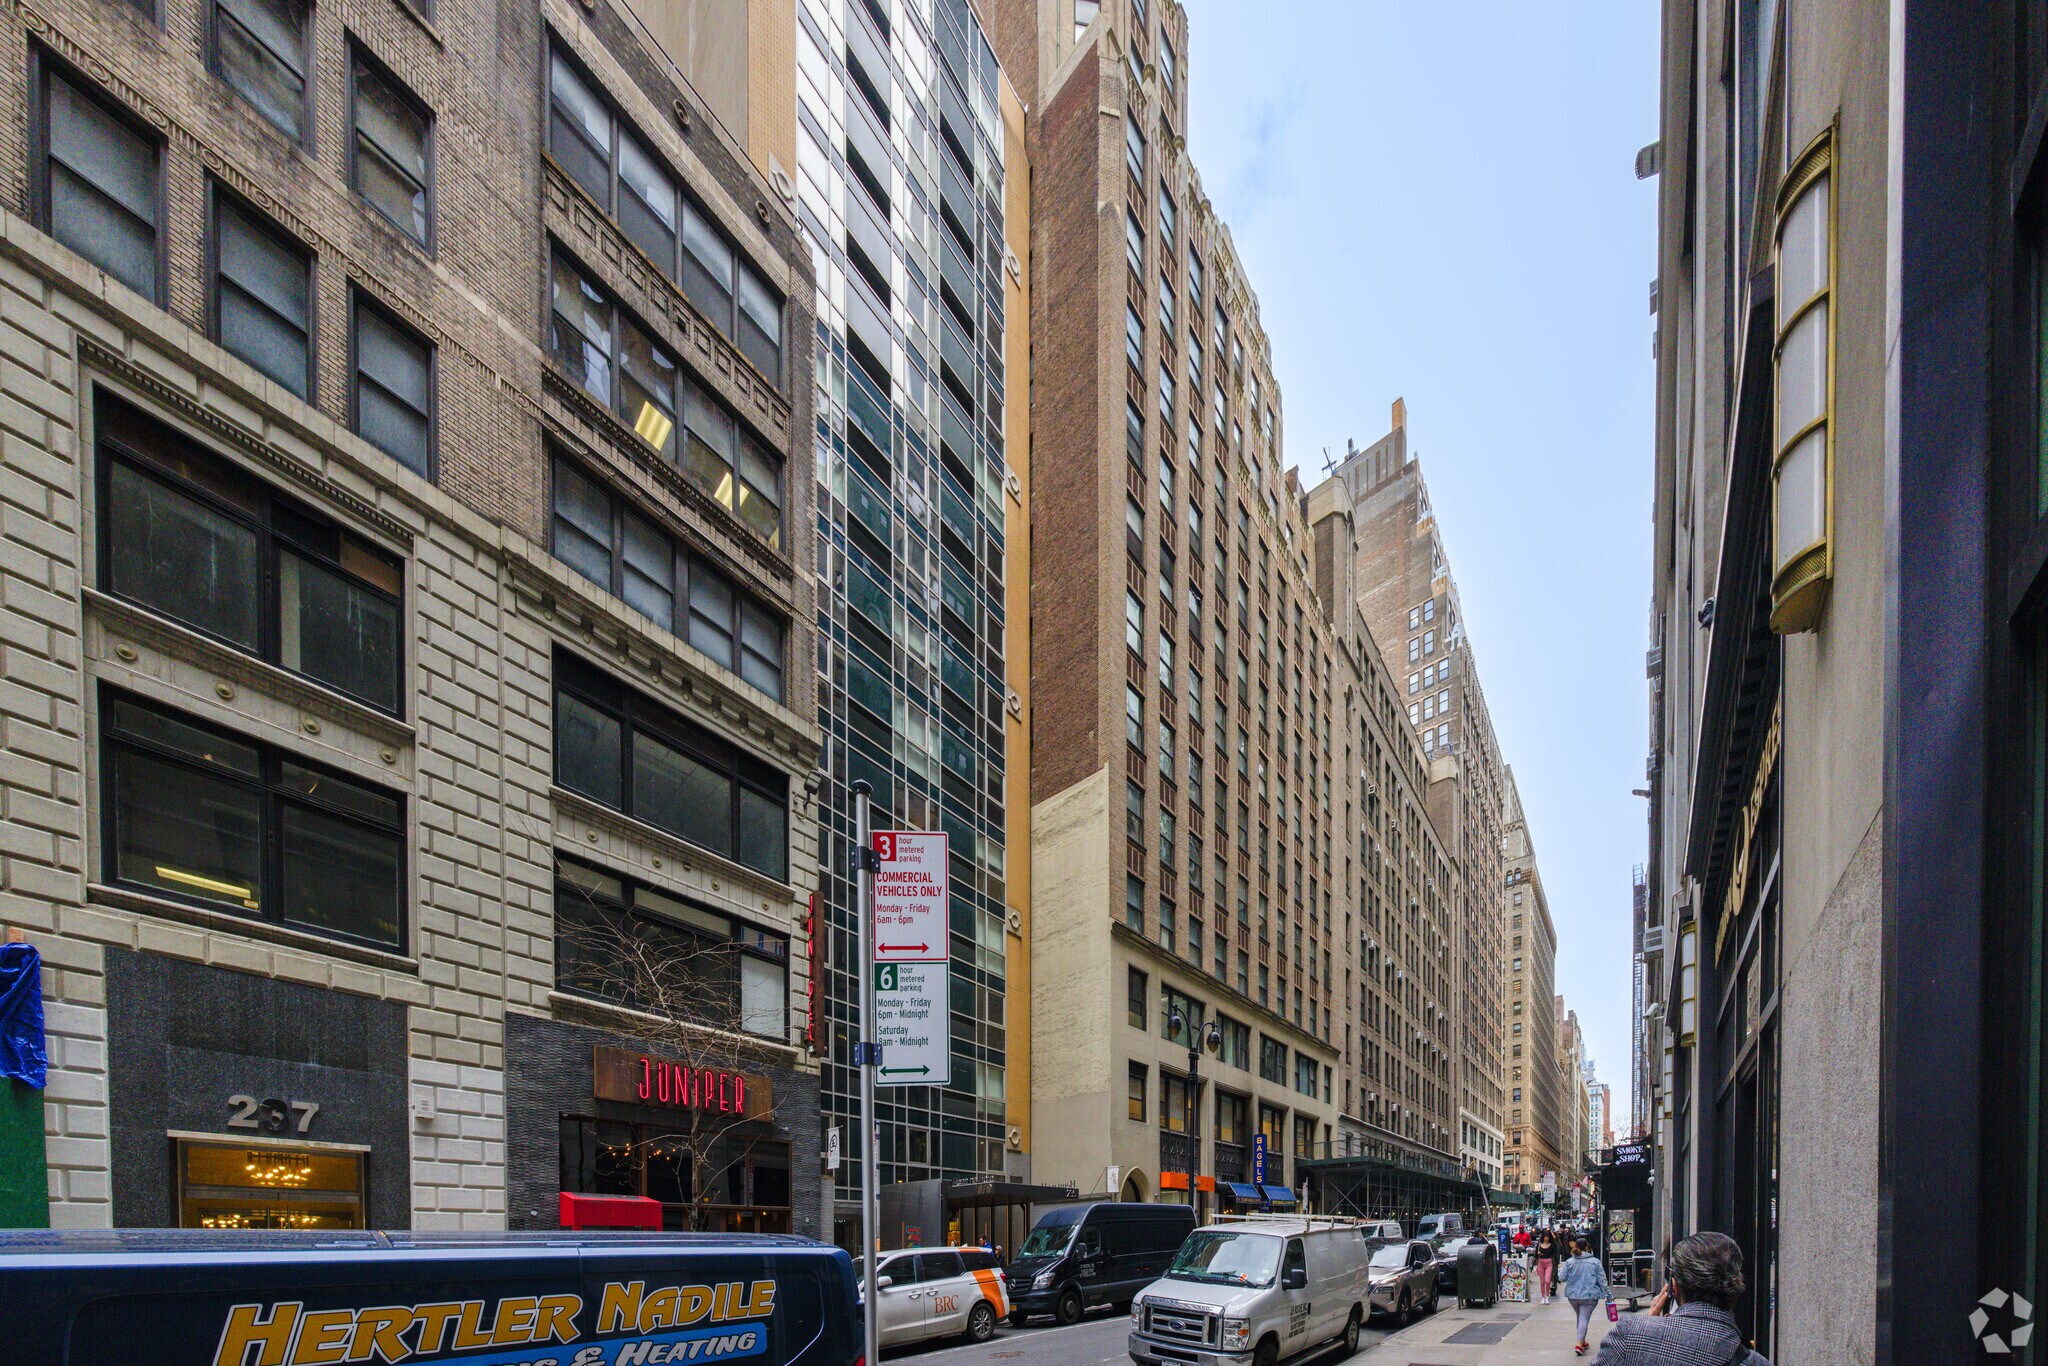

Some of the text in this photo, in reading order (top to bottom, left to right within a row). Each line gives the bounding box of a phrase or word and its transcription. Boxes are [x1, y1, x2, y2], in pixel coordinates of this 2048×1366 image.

[880, 836, 891, 860] 3
[899, 855, 921, 863] parking
[876, 872, 933, 883] COMMERCIAL
[877, 886, 942, 897] VEHICLES ONLY
[877, 904, 902, 914] Monday
[909, 904, 930, 914] Friday
[877, 916, 892, 924] 6am
[899, 916, 914, 925] 6pm
[900, 966, 913, 974] hour
[880, 966, 893, 990] 6
[900, 975, 925, 983] metered
[900, 984, 922, 993] parking
[878, 998, 904, 1008] Monday
[910, 998, 931, 1008] Friday
[878, 1010, 893, 1020] 6pm
[900, 1010, 929, 1020] Midnight
[878, 1026, 909, 1036] Saturday
[900, 1037, 929, 1047] Midnight
[1616, 1146, 1644, 1155] SMOKE
[1620, 1154, 1641, 1162] SHOP
[934, 1295, 960, 1313] BRC
[212, 1280, 776, 1366] HERTLER NADILE
[614, 1332, 757, 1366] HEATING
